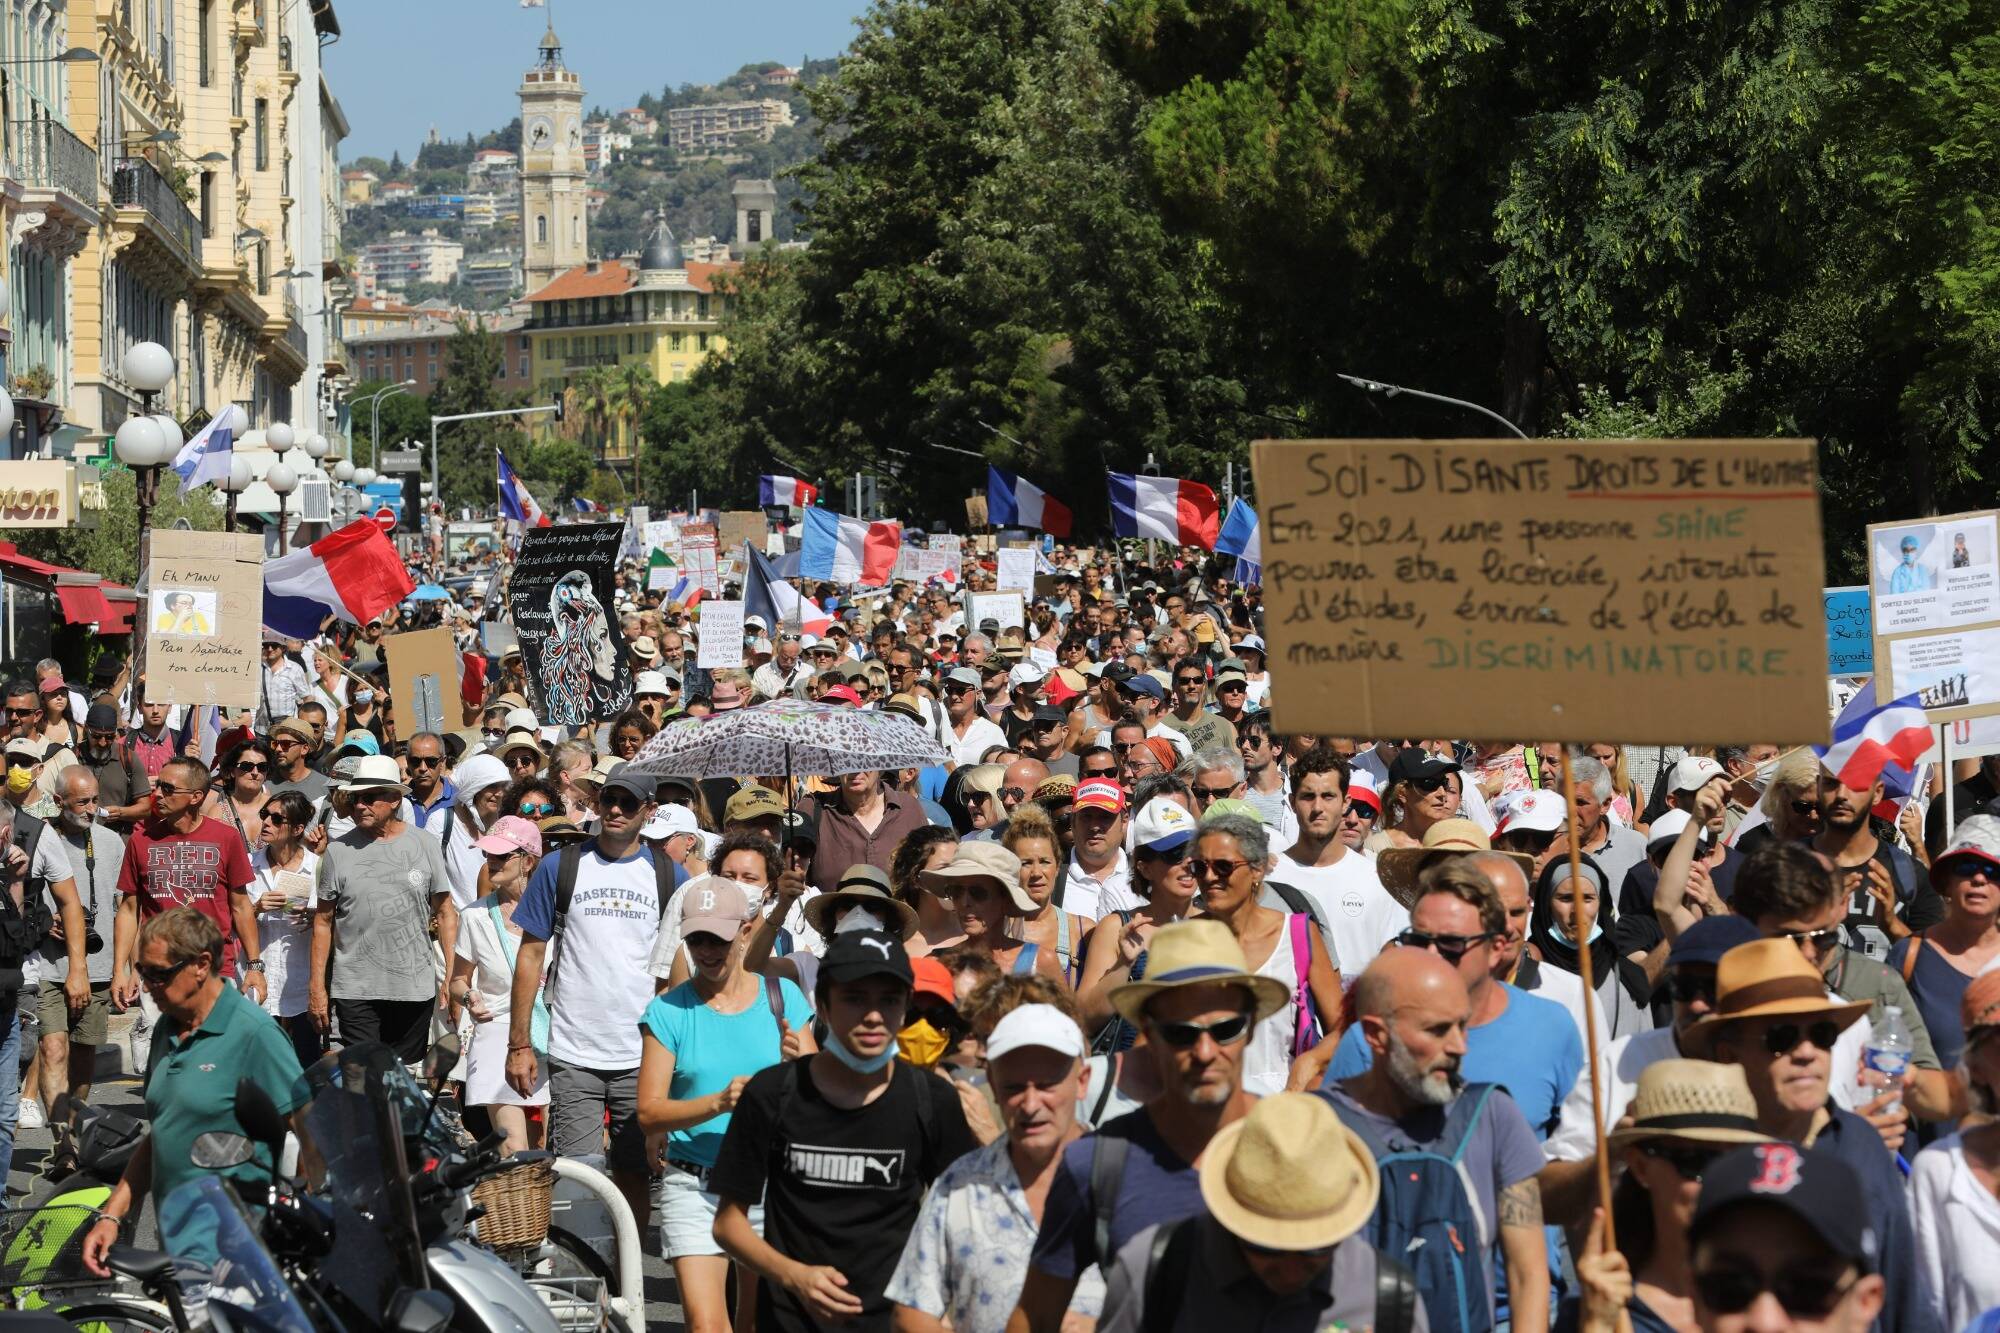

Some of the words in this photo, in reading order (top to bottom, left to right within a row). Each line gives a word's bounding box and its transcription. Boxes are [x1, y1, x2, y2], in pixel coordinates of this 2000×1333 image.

[1671, 457, 1706, 488] DE
[1269, 502, 1317, 544] En
[1439, 520, 1505, 543] une
[1519, 519, 1638, 554] personne
[185, 572, 221, 582] MANU
[1267, 557, 1376, 592] pourra
[1395, 553, 1459, 584] être
[1477, 548, 1620, 600] licenciée,
[1638, 545, 1780, 583] interdite
[511, 592, 530, 605] pour
[1881, 600, 1903, 608] SORTEZ
[1913, 597, 1936, 605] SILENCE
[1283, 588, 1428, 629] d'études,
[1589, 600, 1627, 631] de
[1637, 587, 1746, 635] l'école
[1759, 588, 1804, 629] de
[1896, 608, 1919, 616] SAUVEZ
[1900, 616, 1926, 625] ENFANTS
[1286, 628, 1405, 664] manière
[168, 662, 188, 673] ton
[195, 662, 239, 674] chemin
[245, 660, 251, 677] !
[148, 845, 220, 866] RED
[147, 869, 219, 890] RED
[573, 888, 657, 911] BASKETBALL
[699, 889, 717, 911] B
[584, 907, 648, 920] DEPARTMENT
[790, 1150, 865, 1183] PUMA
[1749, 1143, 1805, 1194] B
